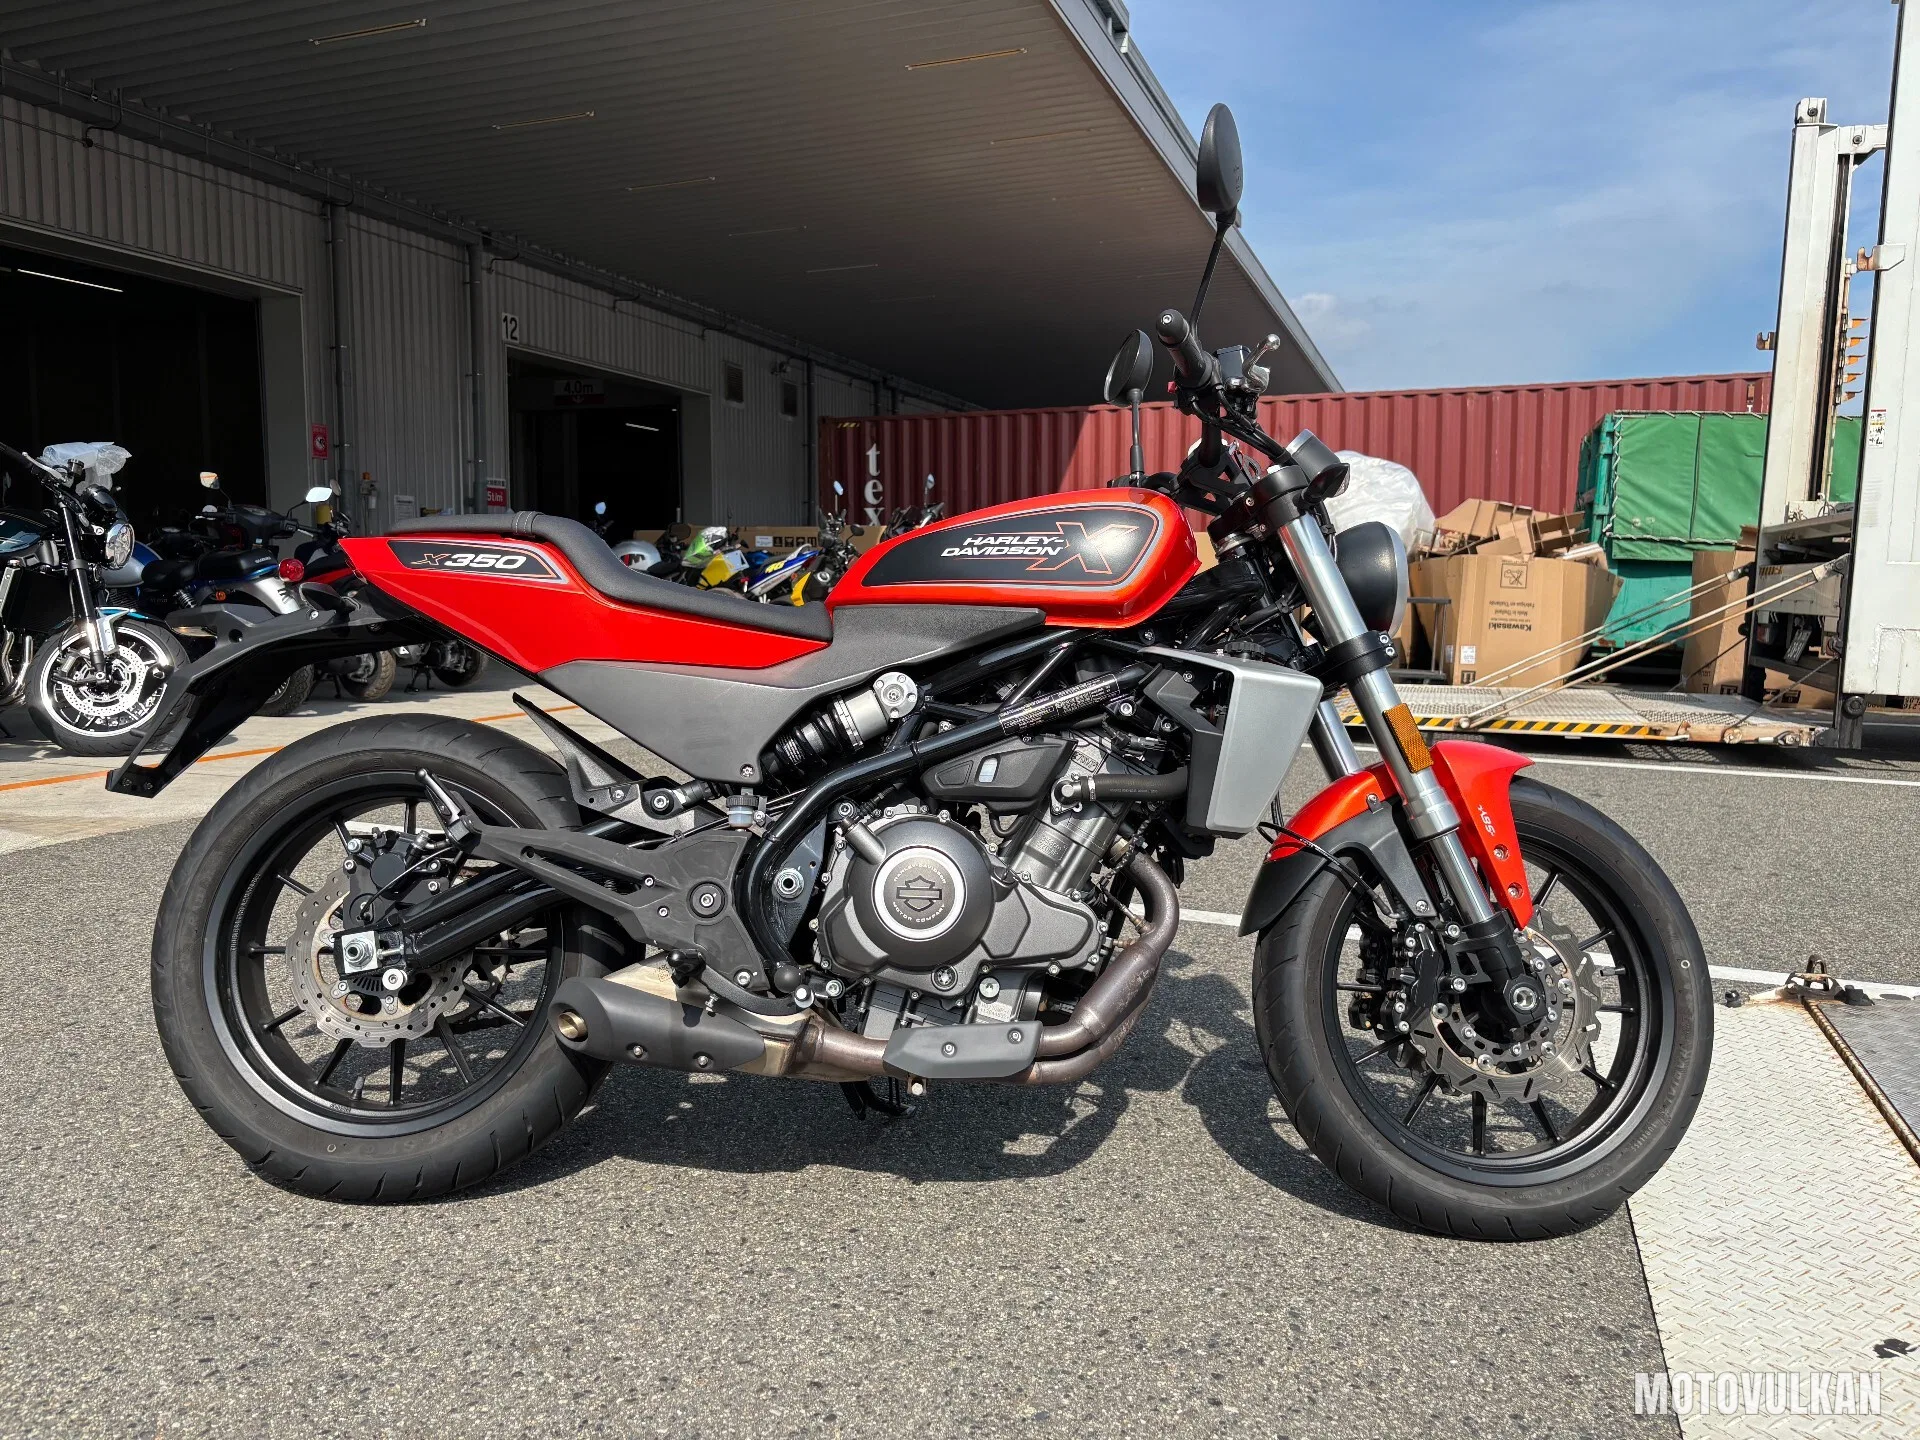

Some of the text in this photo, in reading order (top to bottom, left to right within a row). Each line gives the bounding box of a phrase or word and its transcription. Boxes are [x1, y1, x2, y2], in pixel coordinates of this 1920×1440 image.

[503, 315, 518, 341] 12
[564, 380, 593, 395] 4.0m
[963, 536, 1064, 546] HARLEY-
[941, 546, 1064, 557] DAVIDSON
[1488, 622, 1532, 632] Kawasaki
[893, 901, 945, 922] MOTOR COMPANY
